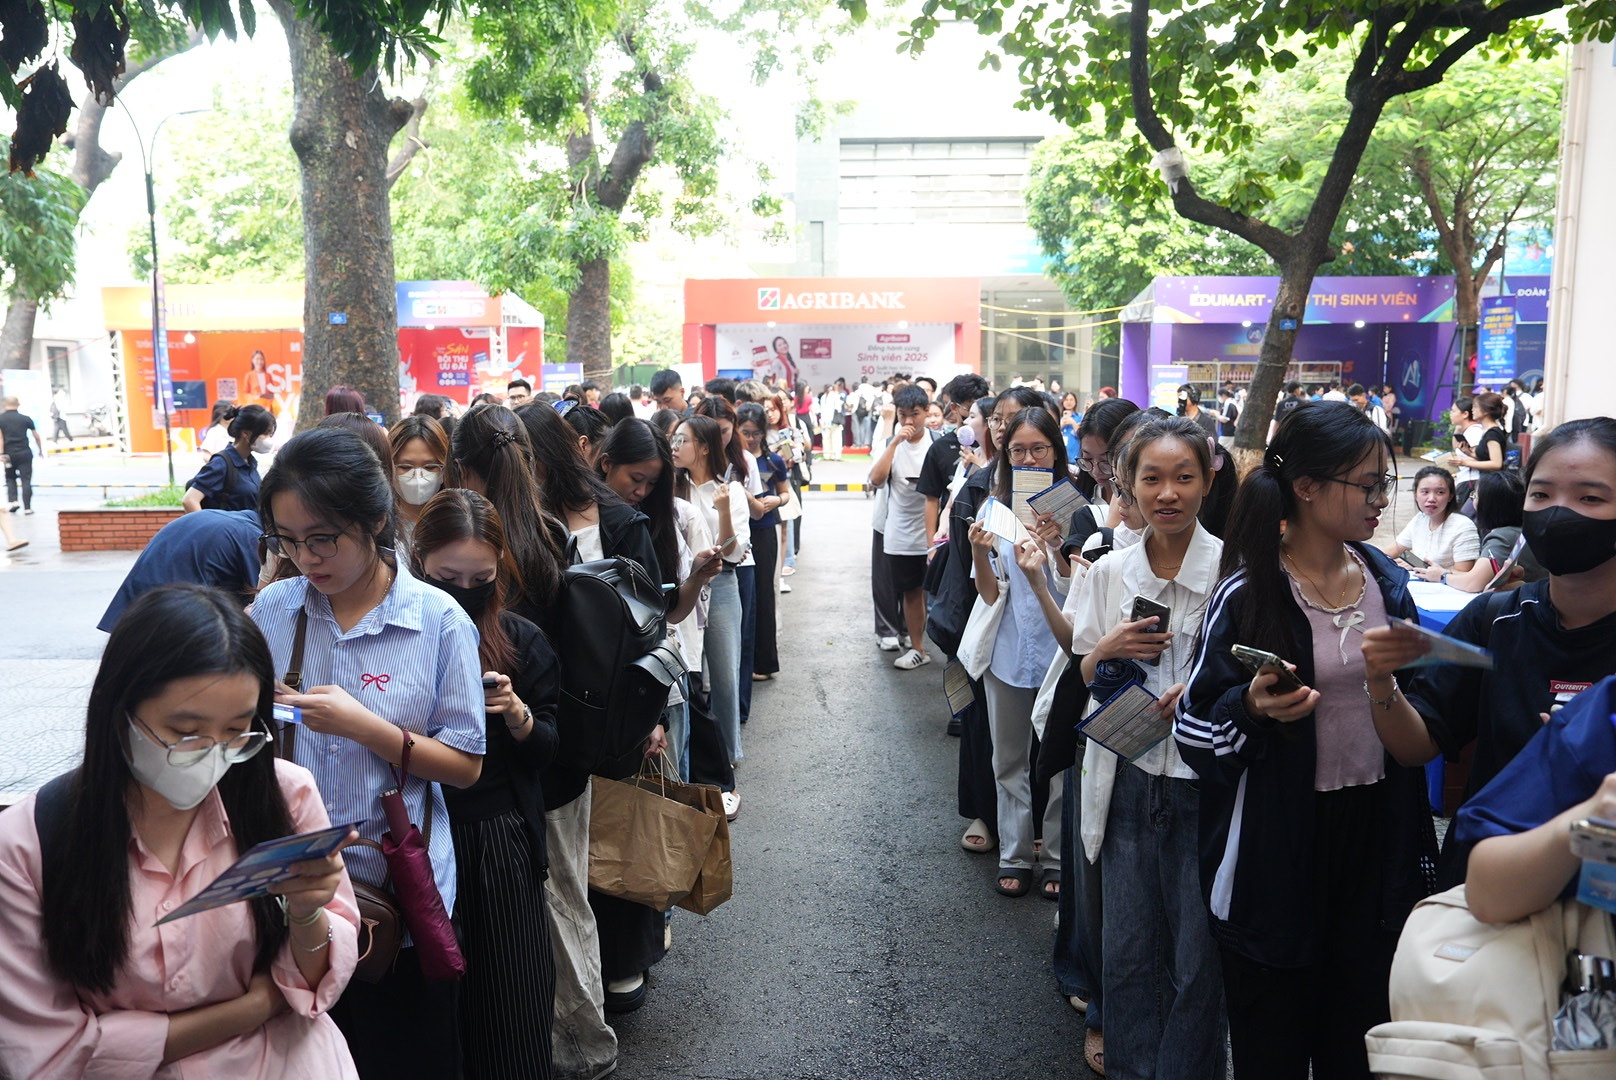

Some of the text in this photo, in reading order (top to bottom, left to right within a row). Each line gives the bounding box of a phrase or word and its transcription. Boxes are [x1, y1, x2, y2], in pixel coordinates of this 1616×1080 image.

[1517, 288, 1547, 297] ĐOÀN
[781, 292, 905, 309] AGRIBANK
[1189, 293, 1267, 306] EDUMART
[1312, 293, 1338, 308] THỊ
[1340, 294, 1378, 306] SINH
[1381, 291, 1418, 305] VIÊN
[857, 353, 928, 362] Sinh viên 2025
[861, 365, 876, 375] 50
[1554, 683, 1588, 691] OUTERITY
